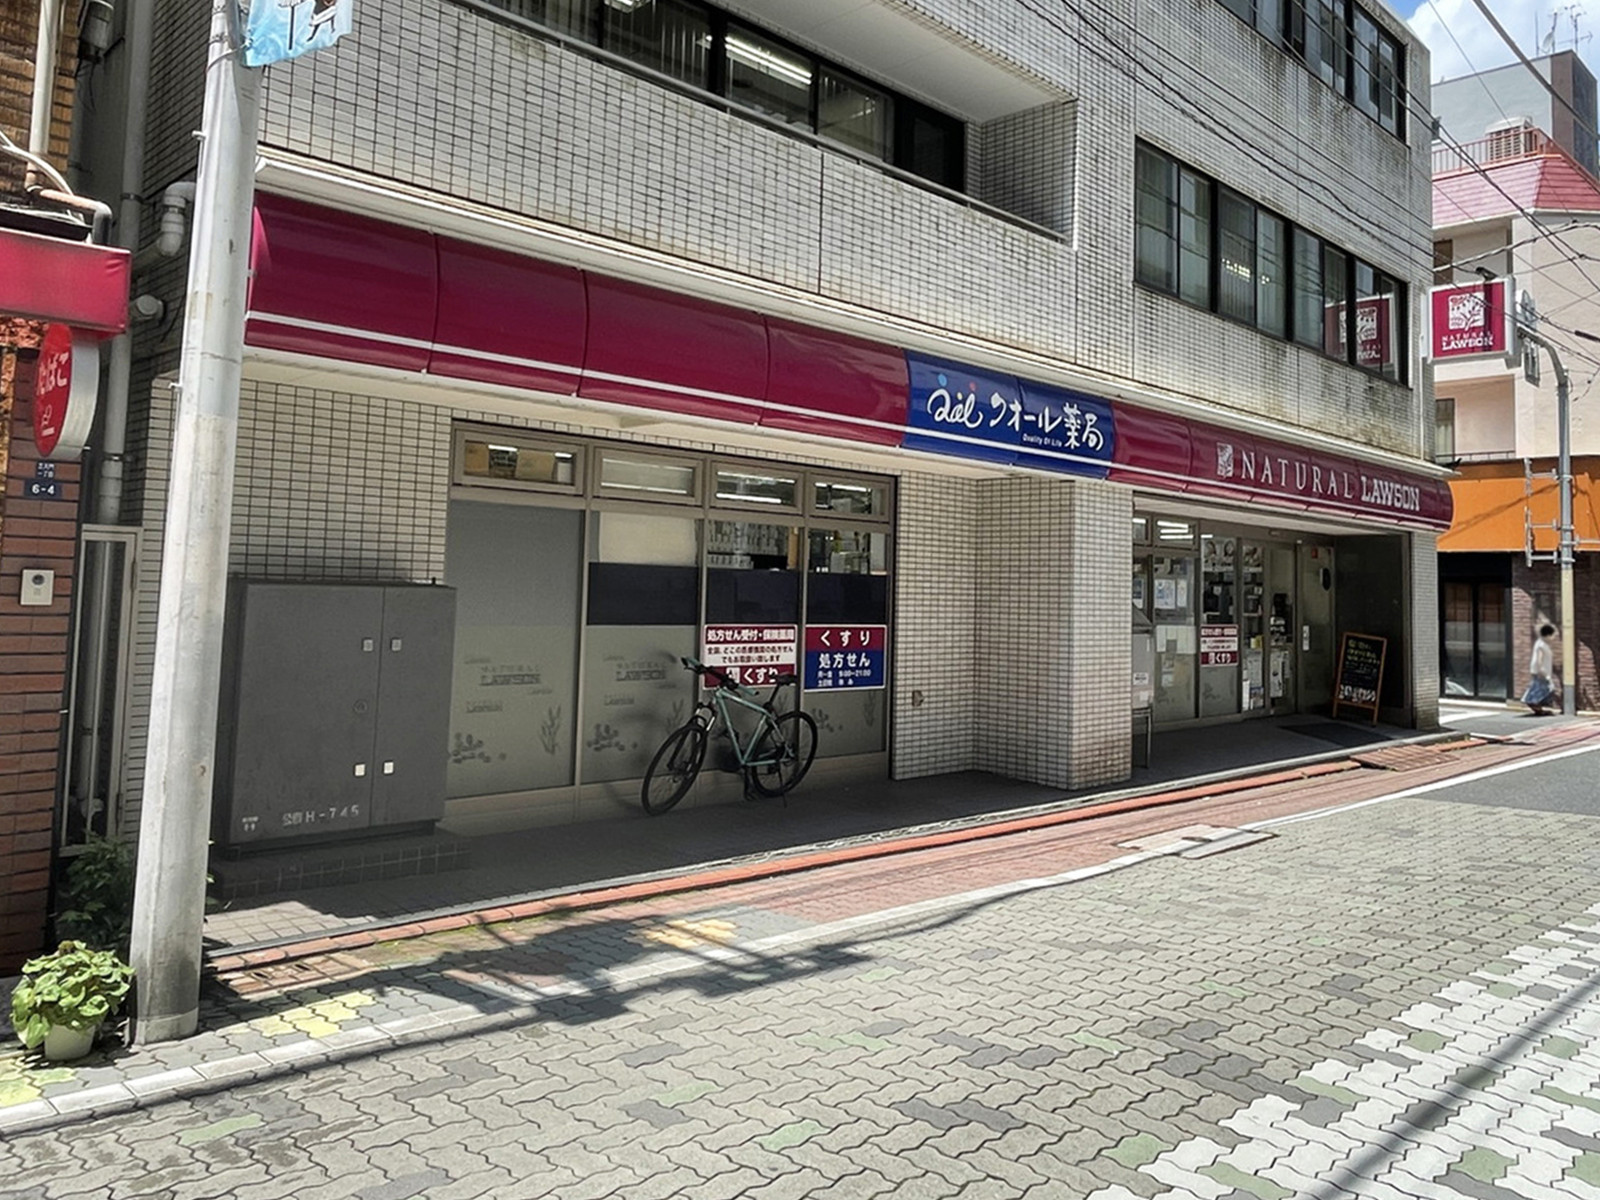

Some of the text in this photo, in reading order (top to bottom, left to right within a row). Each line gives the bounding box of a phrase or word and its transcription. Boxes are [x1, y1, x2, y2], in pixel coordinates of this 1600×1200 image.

[1441, 336, 1494, 351] LAWSON
[1241, 450, 1421, 511] NATURAL LAWSON
[31, 483, 55, 495] 6-4
[820, 630, 871, 647] くすり
[818, 653, 871, 669] 処方せん
[479, 673, 541, 686] LAWSON
[615, 669, 667, 682] LAWSON
